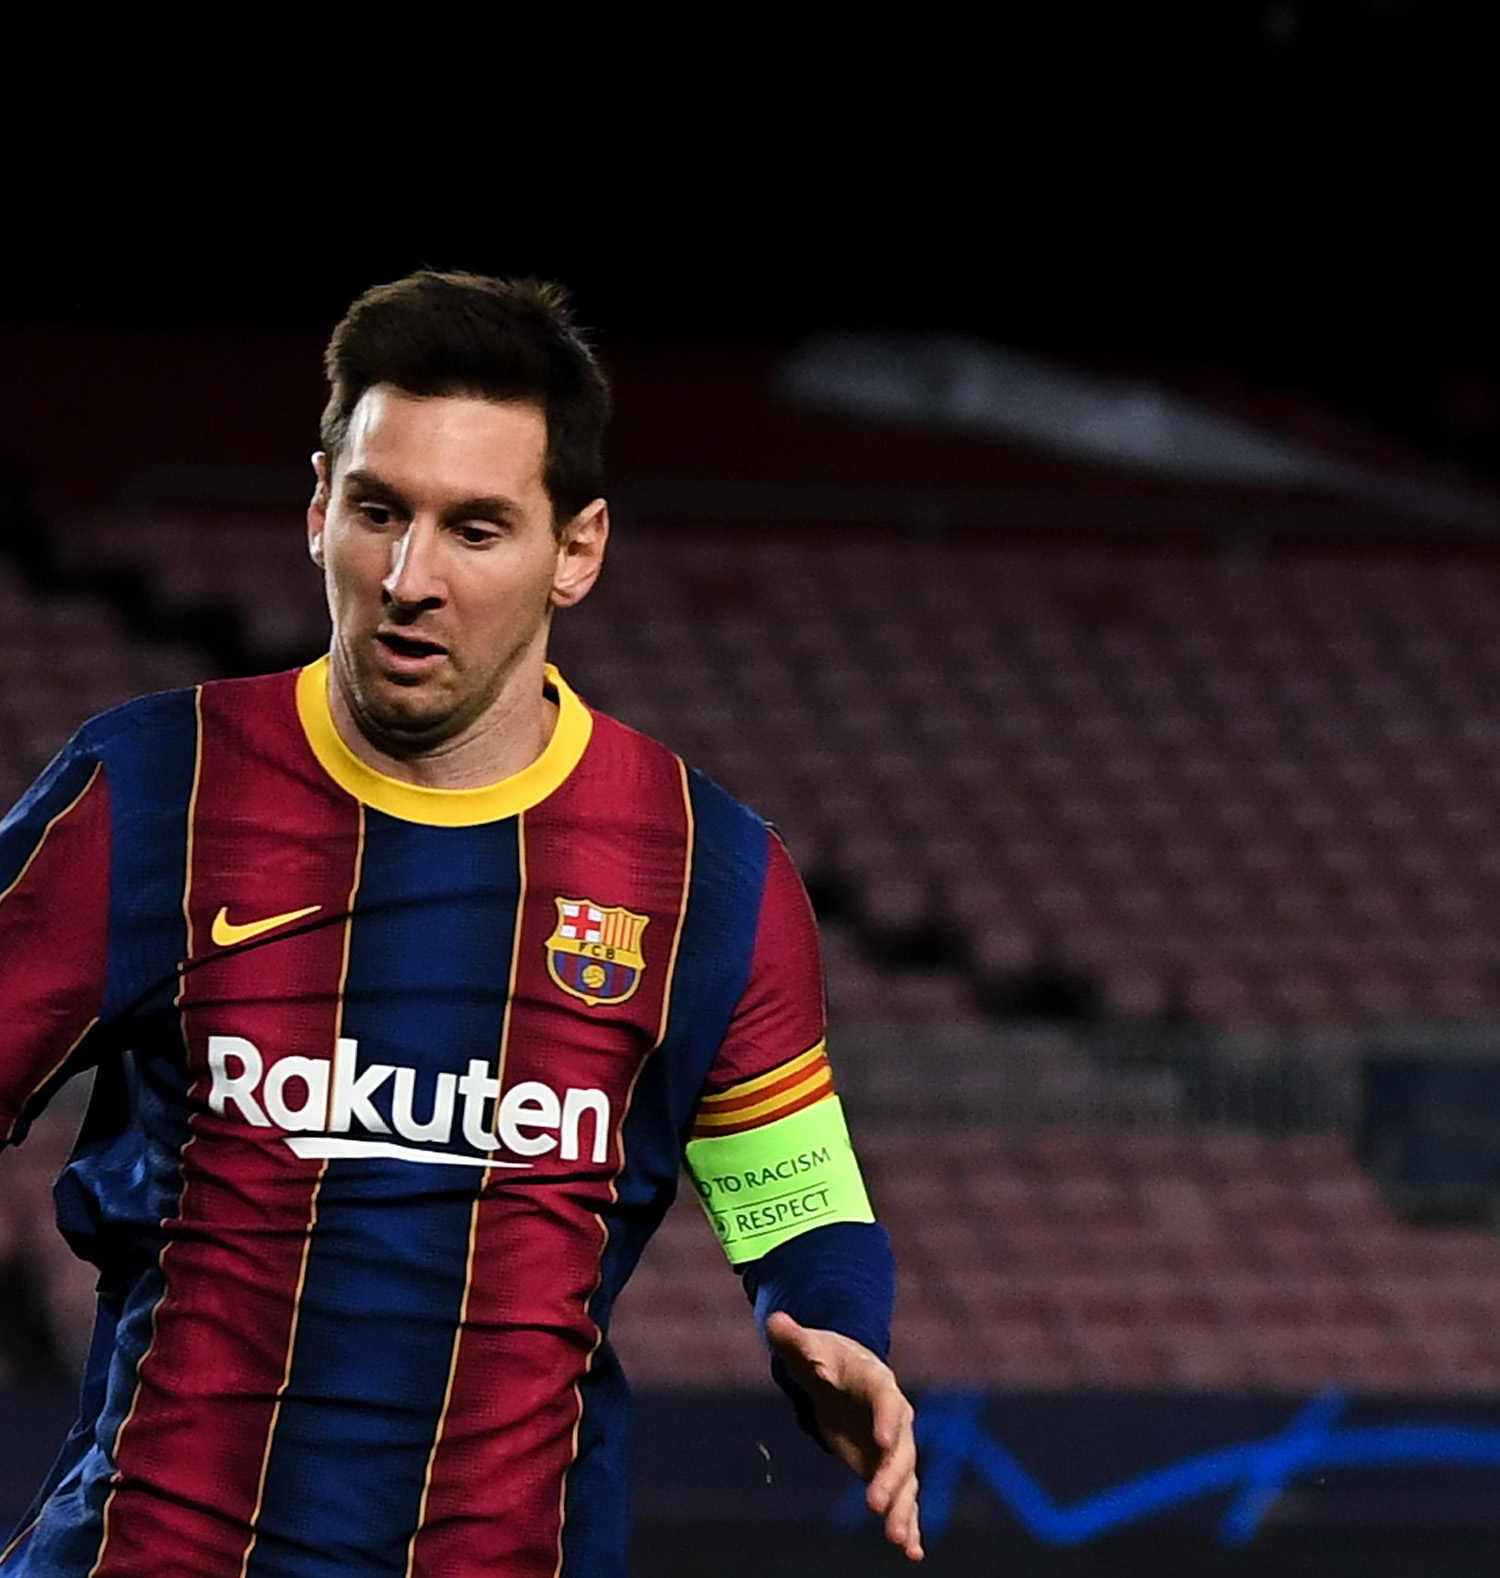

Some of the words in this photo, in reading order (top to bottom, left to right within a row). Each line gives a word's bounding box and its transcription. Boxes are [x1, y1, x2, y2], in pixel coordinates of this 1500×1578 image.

[578, 942, 616, 960] FCB
[207, 1034, 612, 1164] Rakuten
[712, 1174, 742, 1193] TO
[743, 1146, 832, 1188] RACISM
[736, 1188, 830, 1233] RESPECT
